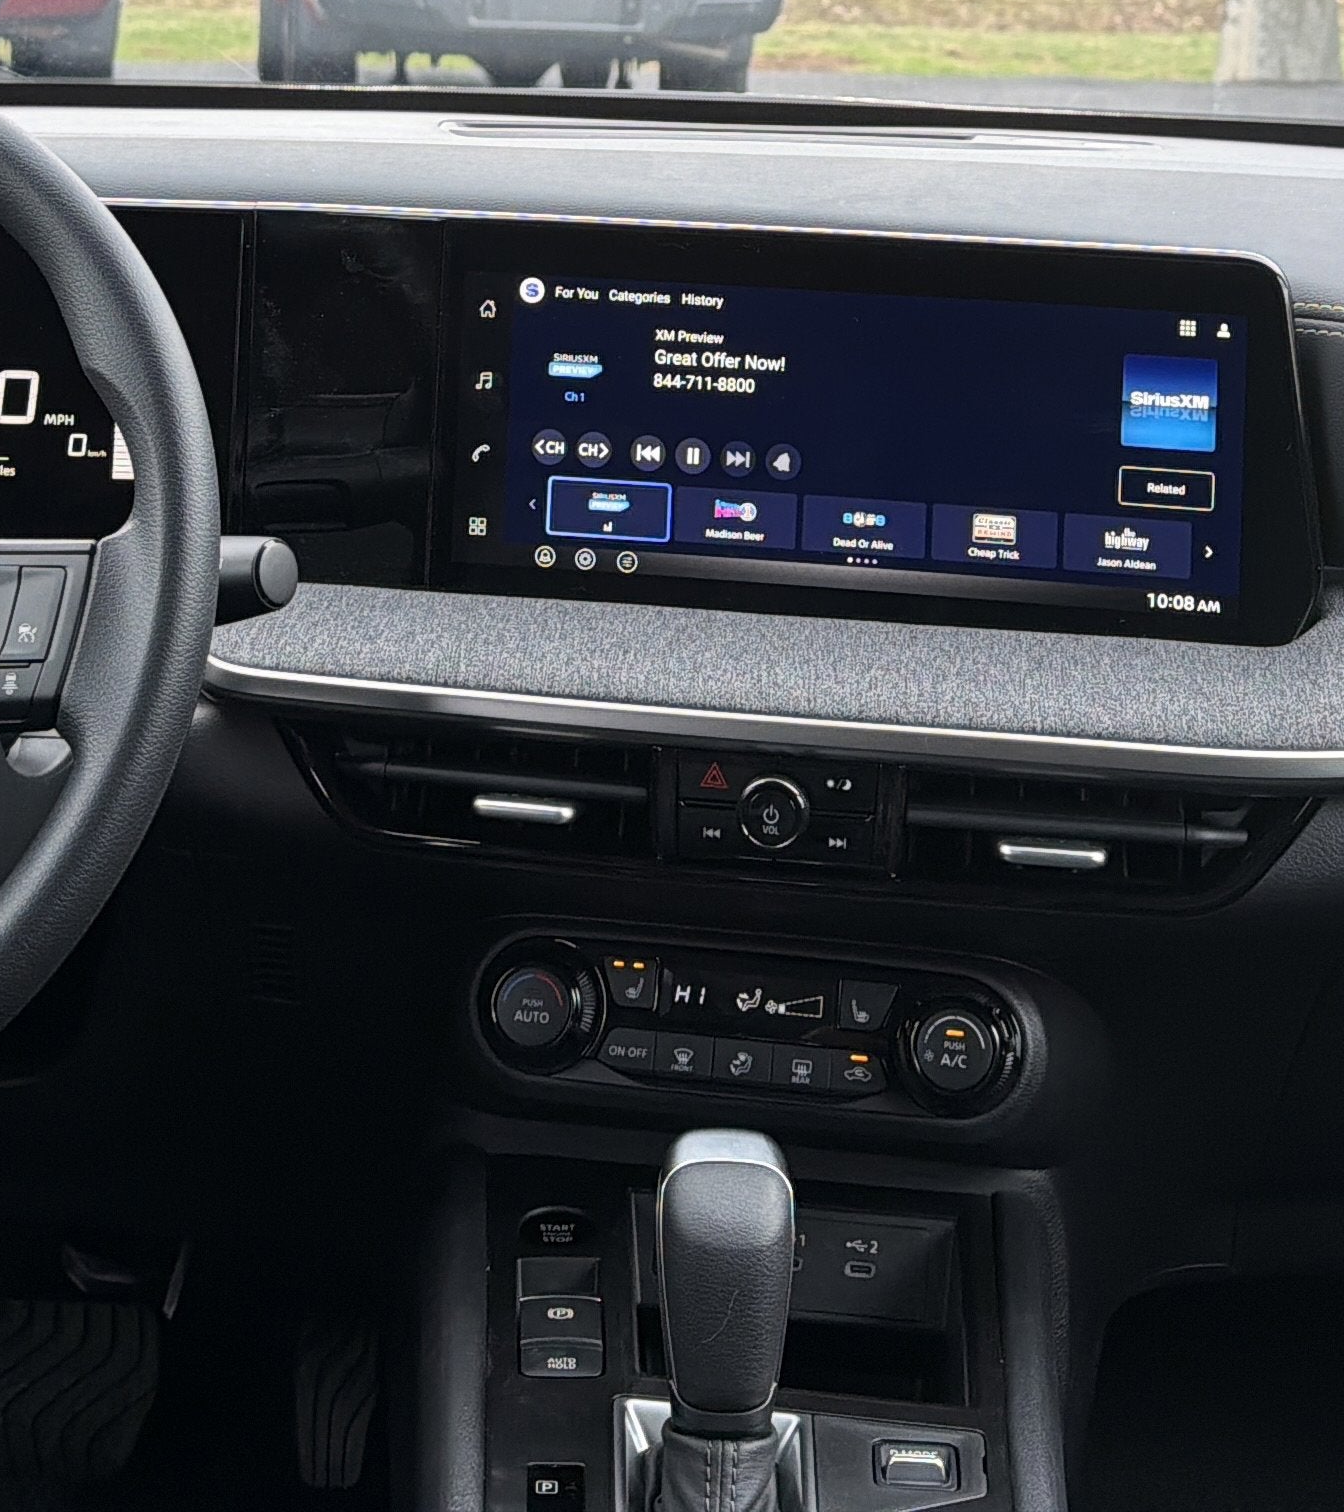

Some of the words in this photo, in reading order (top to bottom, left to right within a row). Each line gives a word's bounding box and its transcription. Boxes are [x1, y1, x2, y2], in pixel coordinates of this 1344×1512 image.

[554, 286, 575, 300] For
[576, 287, 599, 301] You
[609, 288, 671, 305] Categories
[681, 292, 724, 309] History
[655, 329, 675, 342] XM
[677, 330, 724, 345] Preview
[654, 349, 698, 367] Great
[701, 351, 741, 369] Offer
[744, 354, 786, 372] Now!
[653, 372, 755, 393] 844-711-8800
[564, 390, 578, 402] Ch
[579, 391, 585, 402] 1
[1130, 390, 1210, 410] SiriusXM
[43, 414, 74, 426] MPH
[67, 433, 88, 457] 0
[1146, 481, 1186, 496] Related
[705, 528, 742, 540] Madison
[743, 530, 765, 542] Beer
[832, 537, 856, 549] Dead
[857, 539, 870, 550] Or
[870, 539, 894, 552] Alive
[967, 547, 997, 560] Cheap
[998, 548, 1020, 561] Trick
[1096, 556, 1123, 569] Jason
[1123, 558, 1157, 571] Aldean
[1147, 593, 1195, 612] 10:08
[1197, 599, 1222, 614] AM
[762, 825, 780, 836] VOL
[522, 998, 544, 1008] PUSH
[514, 1009, 550, 1024] AUTO
[608, 1045, 625, 1056] ON
[628, 1046, 649, 1059] OFF
[943, 1040, 966, 1052] PUSH
[670, 1063, 694, 1072] FRONT
[940, 1053, 967, 1069] A/C
[791, 1076, 810, 1085] REAR
[540, 1223, 576, 1232] START
[869, 1240, 879, 1254] 2
